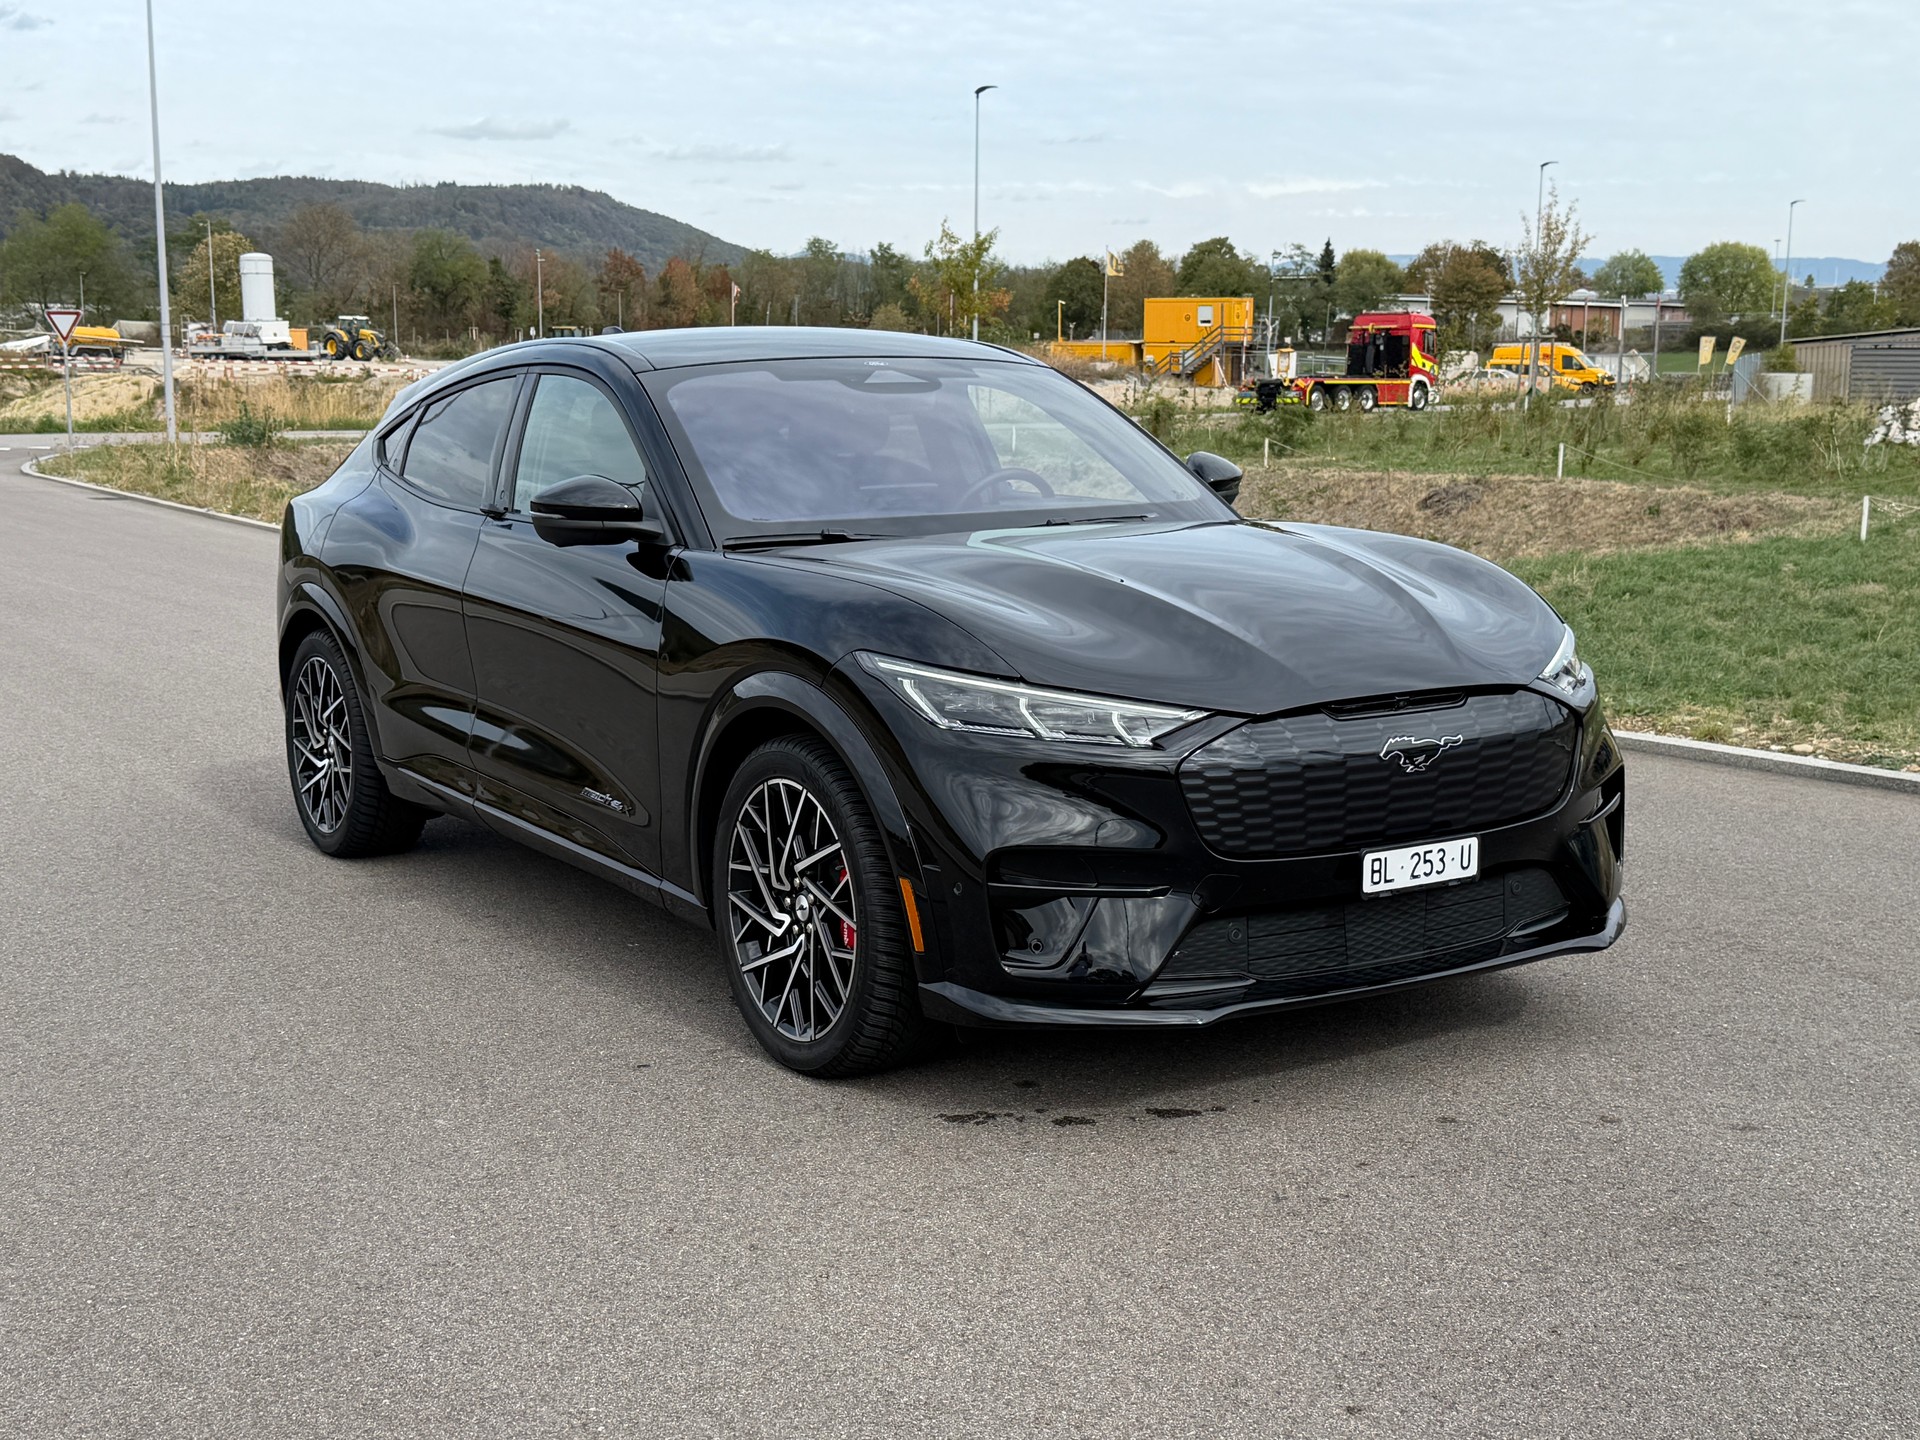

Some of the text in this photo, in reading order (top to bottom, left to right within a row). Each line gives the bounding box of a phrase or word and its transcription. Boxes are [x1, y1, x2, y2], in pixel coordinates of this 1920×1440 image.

[1370, 843, 1472, 885] BL 253 U
